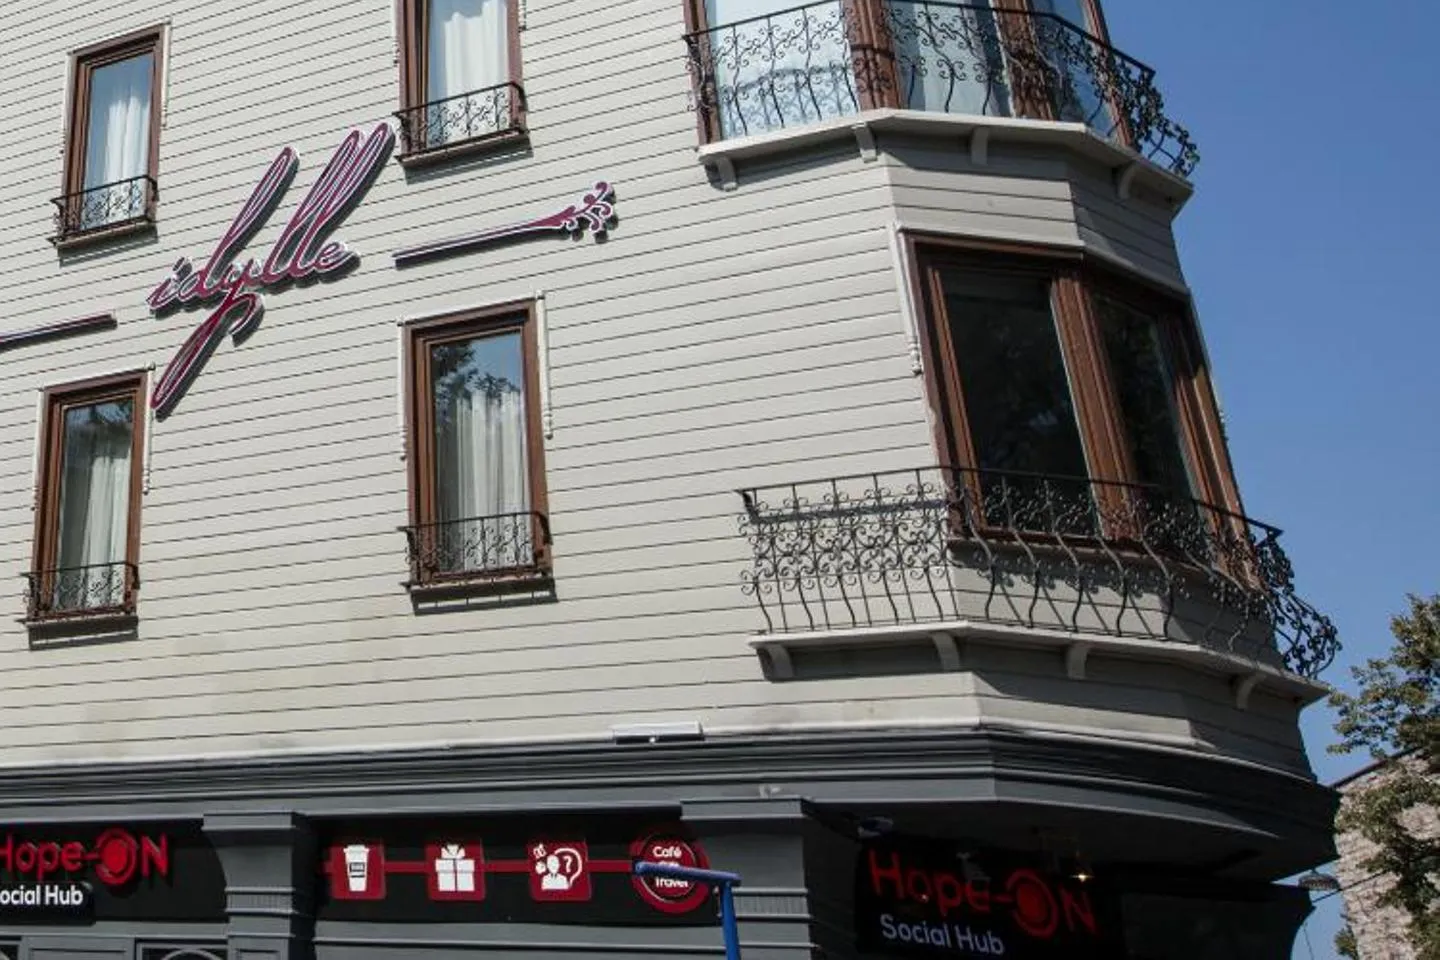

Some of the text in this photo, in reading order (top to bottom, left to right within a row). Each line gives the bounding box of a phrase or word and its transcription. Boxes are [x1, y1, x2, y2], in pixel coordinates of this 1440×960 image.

[146, 122, 394, 416] idylle
[652, 846, 682, 858] Café
[45, 885, 84, 906] Hub
[880, 913, 1006, 956] Social Hub
